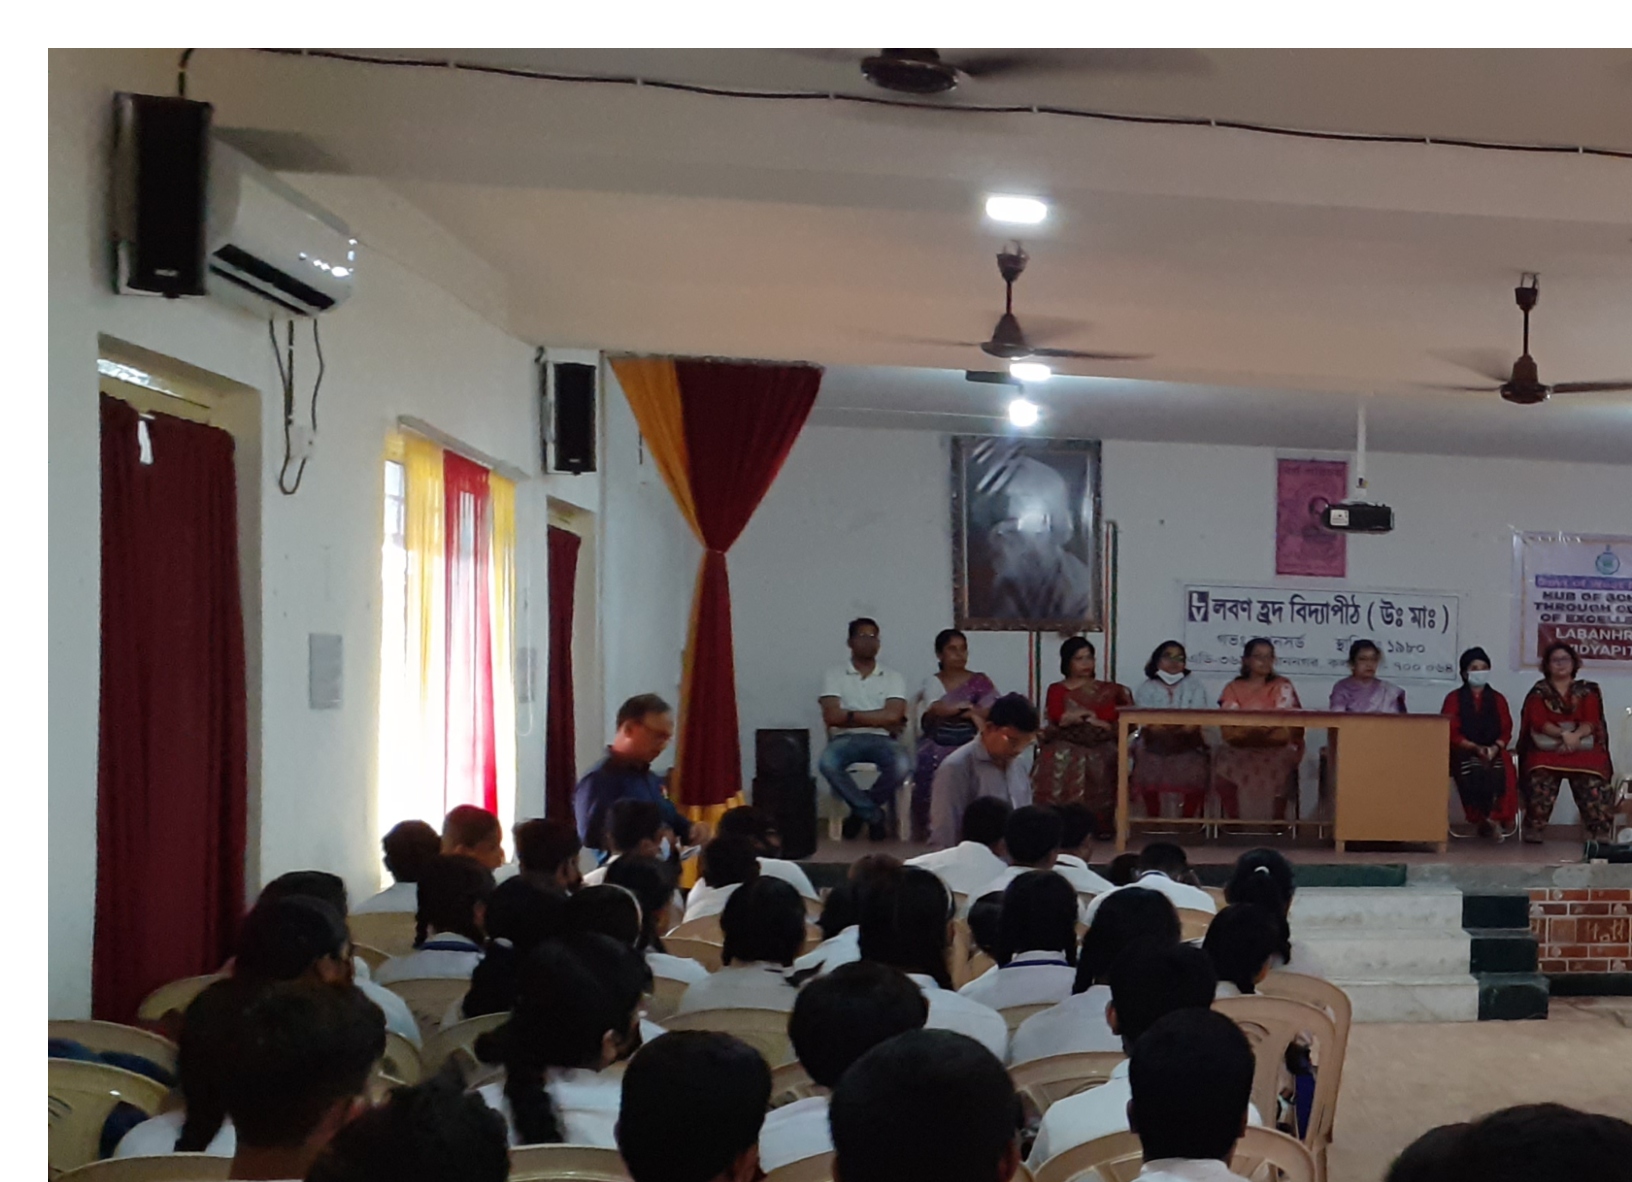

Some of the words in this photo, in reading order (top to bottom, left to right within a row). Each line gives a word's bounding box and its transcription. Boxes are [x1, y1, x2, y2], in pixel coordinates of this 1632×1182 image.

[1542, 591, 1576, 601] HUB
[1581, 592, 1602, 602] OF
[1211, 597, 1253, 620] লবণ
[1256, 600, 1285, 625] হ্রদ
[1288, 594, 1361, 625] বিদ্যাপীঠ
[1533, 602, 1611, 613] THROUGH
[1540, 613, 1561, 622] OF
[1387, 640, 1425, 653] ১৯৮০
